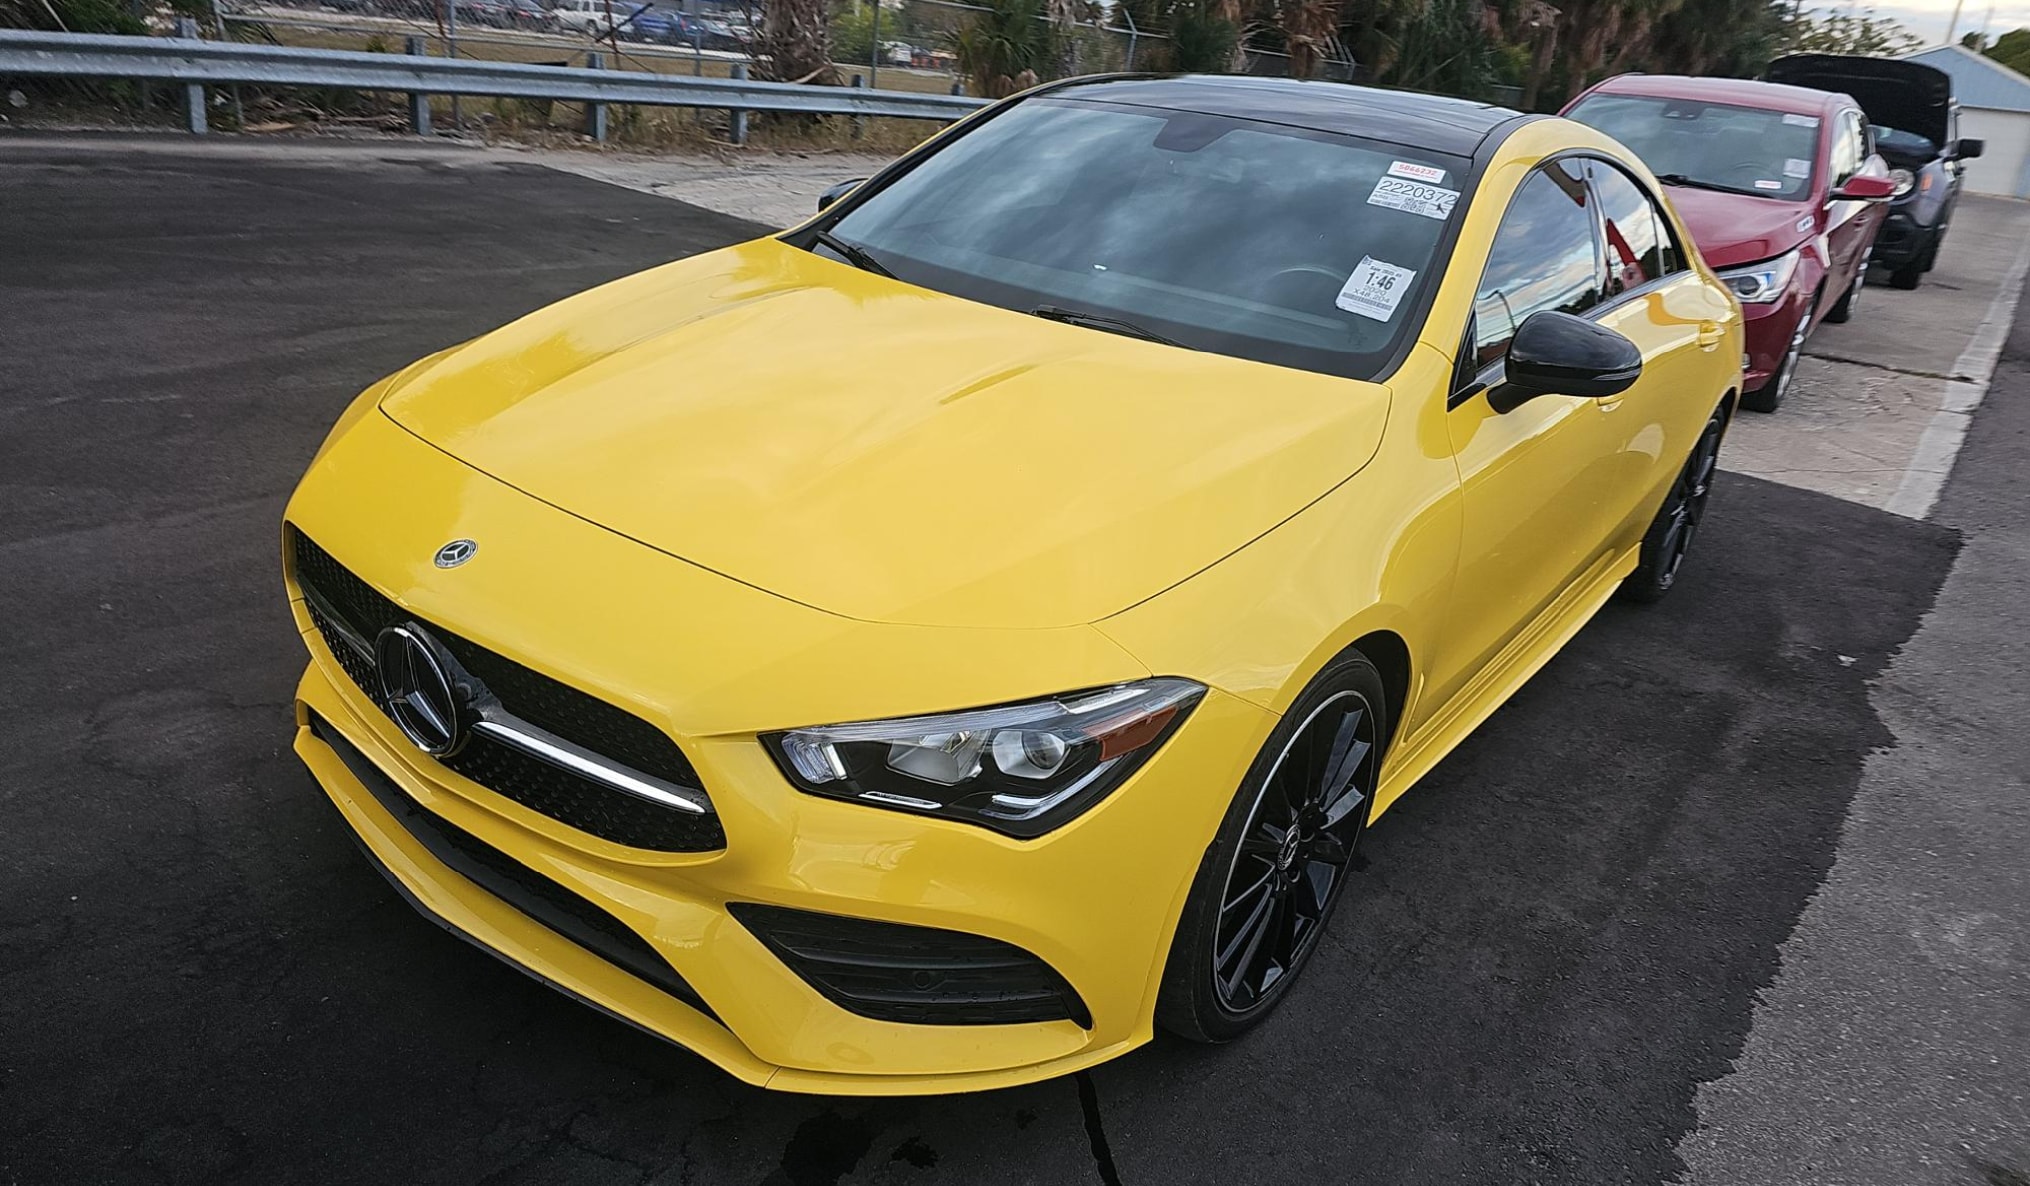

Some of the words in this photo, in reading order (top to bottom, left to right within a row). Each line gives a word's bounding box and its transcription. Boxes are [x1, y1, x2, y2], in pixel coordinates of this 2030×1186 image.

[1379, 180, 1458, 206] 2220372
[1365, 271, 1396, 290] 1:46
[1363, 285, 1388, 296] 2020
